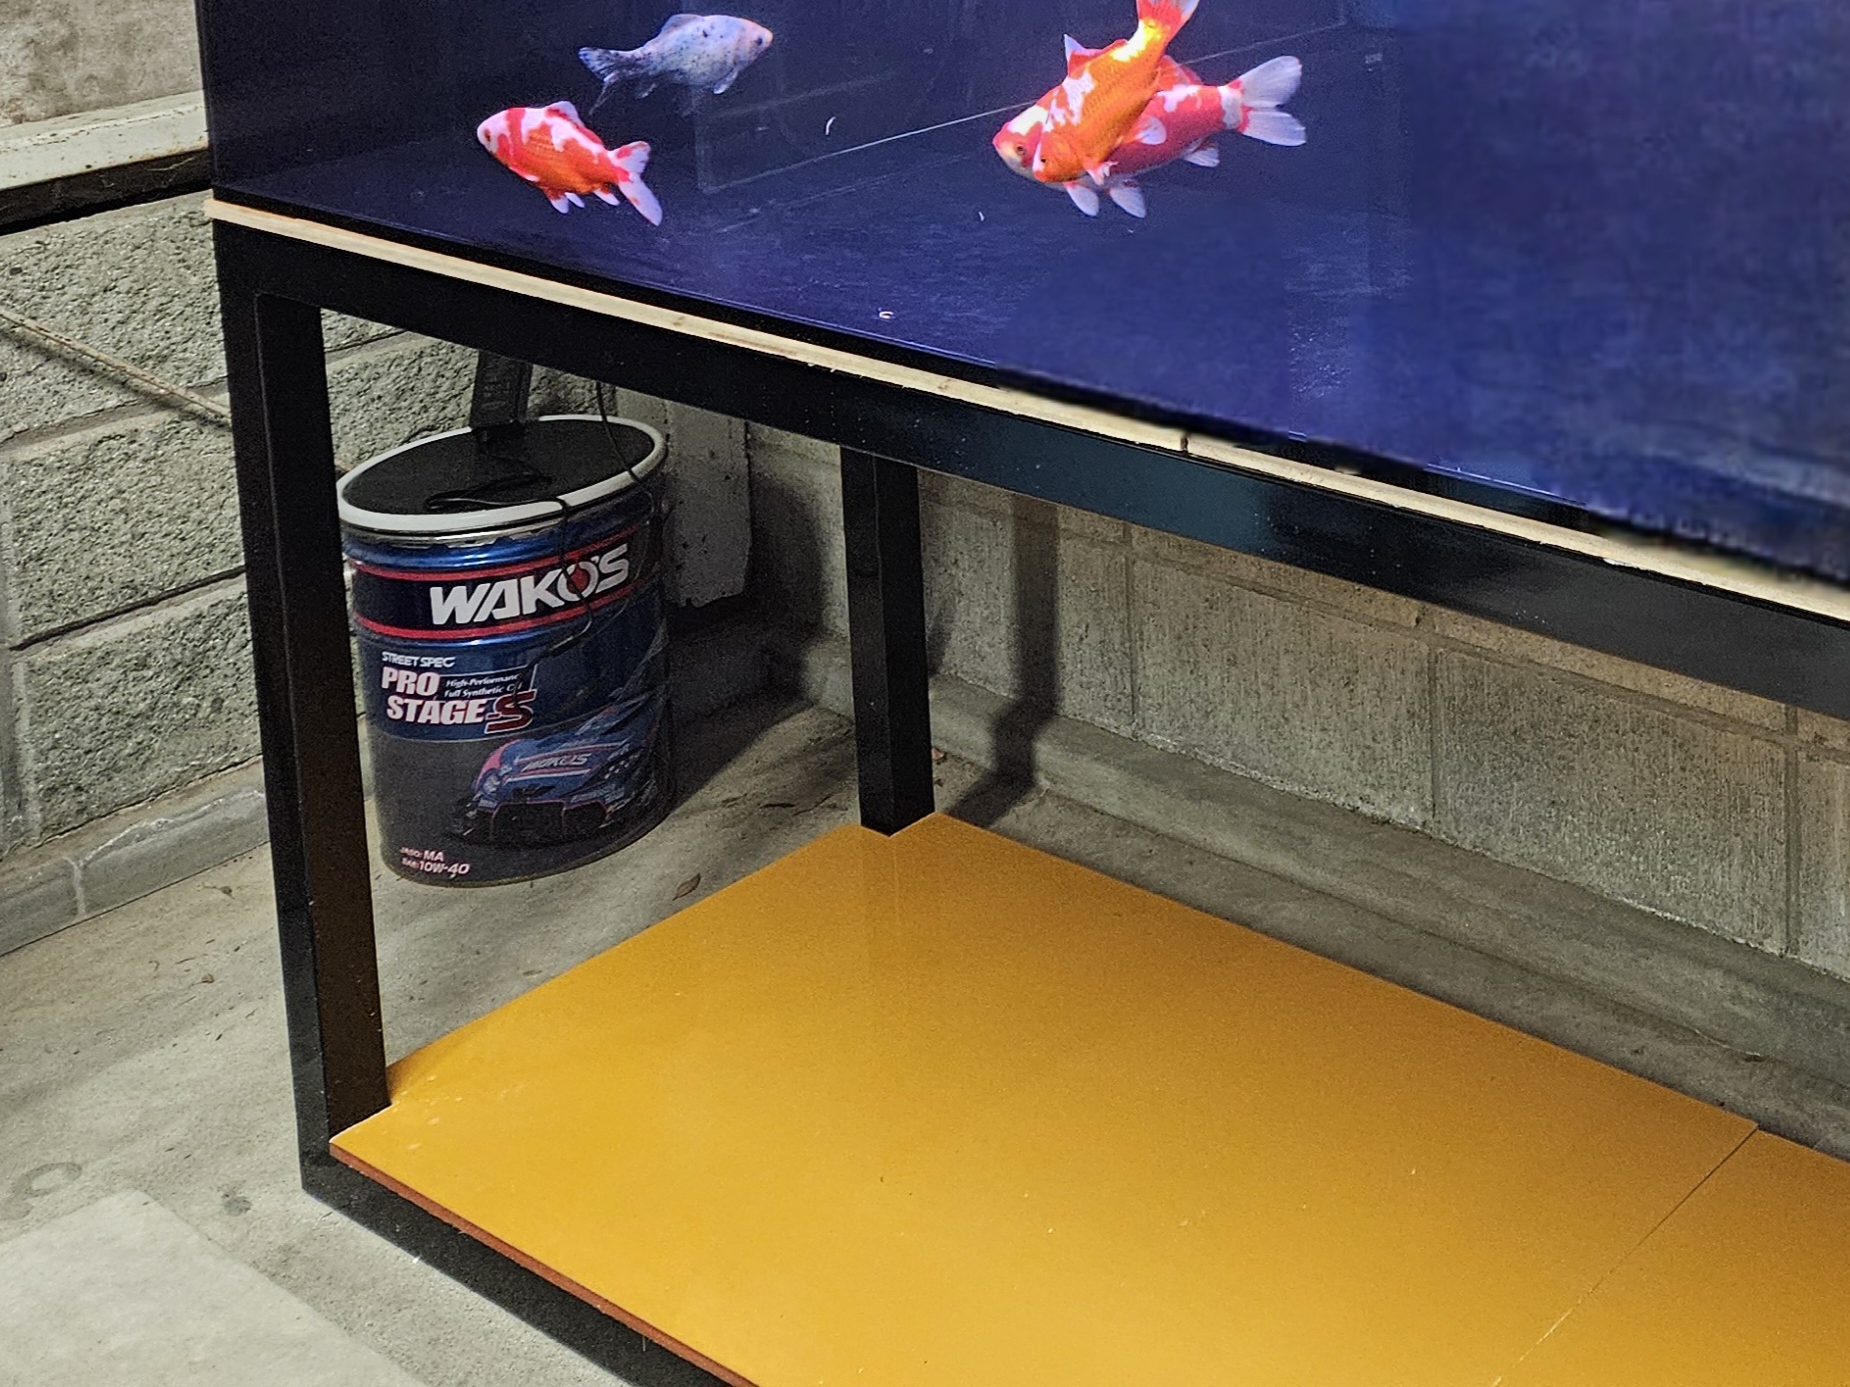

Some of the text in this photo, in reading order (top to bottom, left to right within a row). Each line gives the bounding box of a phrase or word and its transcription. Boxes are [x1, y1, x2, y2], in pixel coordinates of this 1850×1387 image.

[430, 543, 629, 625] WAKO'S
[382, 651, 456, 668] STREET SPEC
[381, 666, 441, 696] PRO
[446, 674, 522, 688] High-Performanc
[462, 685, 505, 699] Synthetic
[387, 695, 487, 725] STAGE
[423, 850, 444, 862] MA
